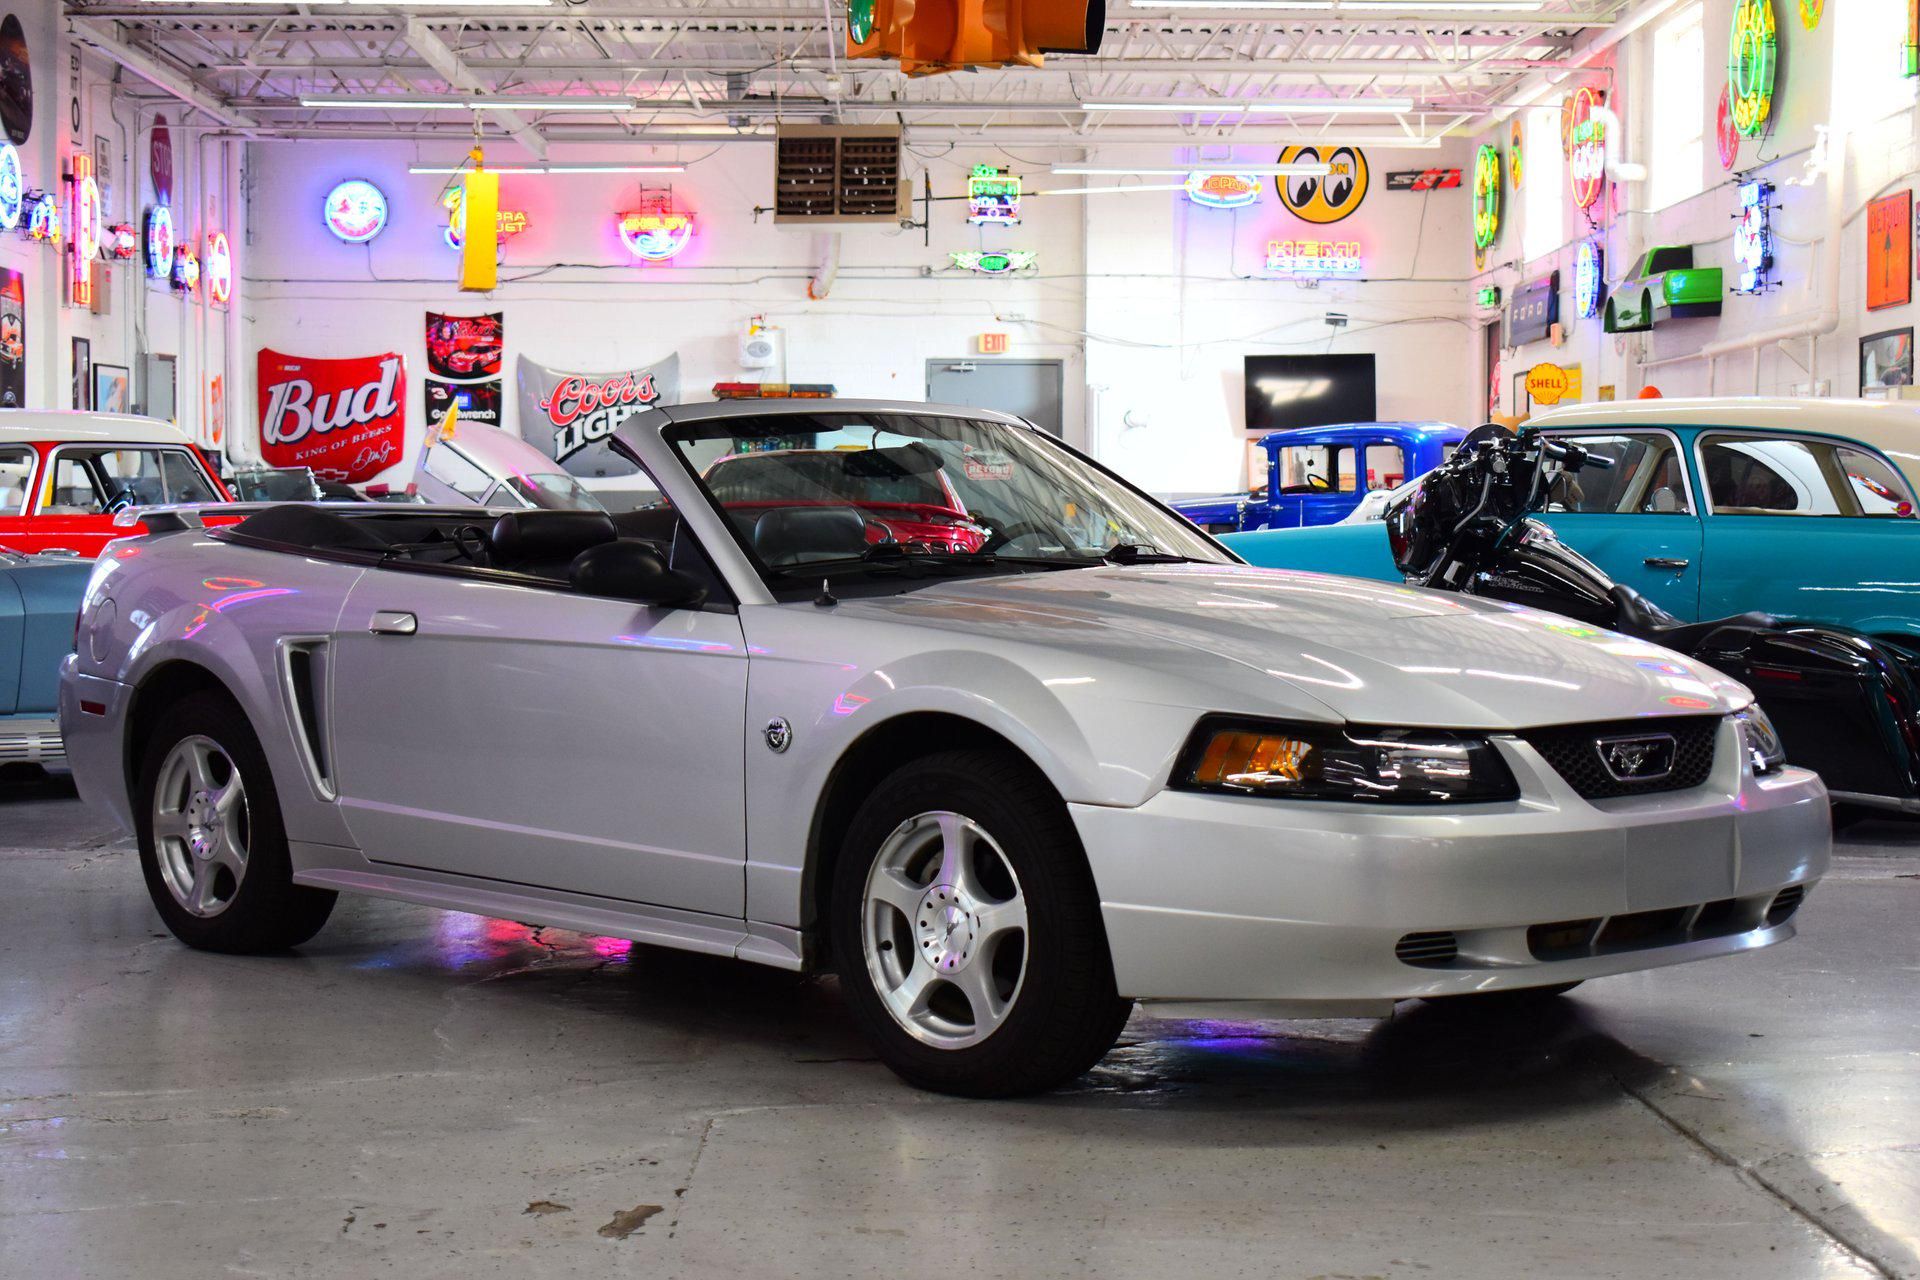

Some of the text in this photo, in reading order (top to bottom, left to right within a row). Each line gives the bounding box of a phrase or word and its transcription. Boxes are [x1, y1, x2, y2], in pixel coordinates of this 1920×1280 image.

[1268, 241, 1360, 258] HEMI
[1512, 301, 1544, 321] FORD
[984, 333, 1006, 352] EXIT
[431, 387, 448, 400] 3
[1530, 379, 1562, 389] SHELL
[263, 358, 398, 446] Bud
[540, 371, 660, 427] Coors
[295, 425, 392, 461] KING OF BEERS
